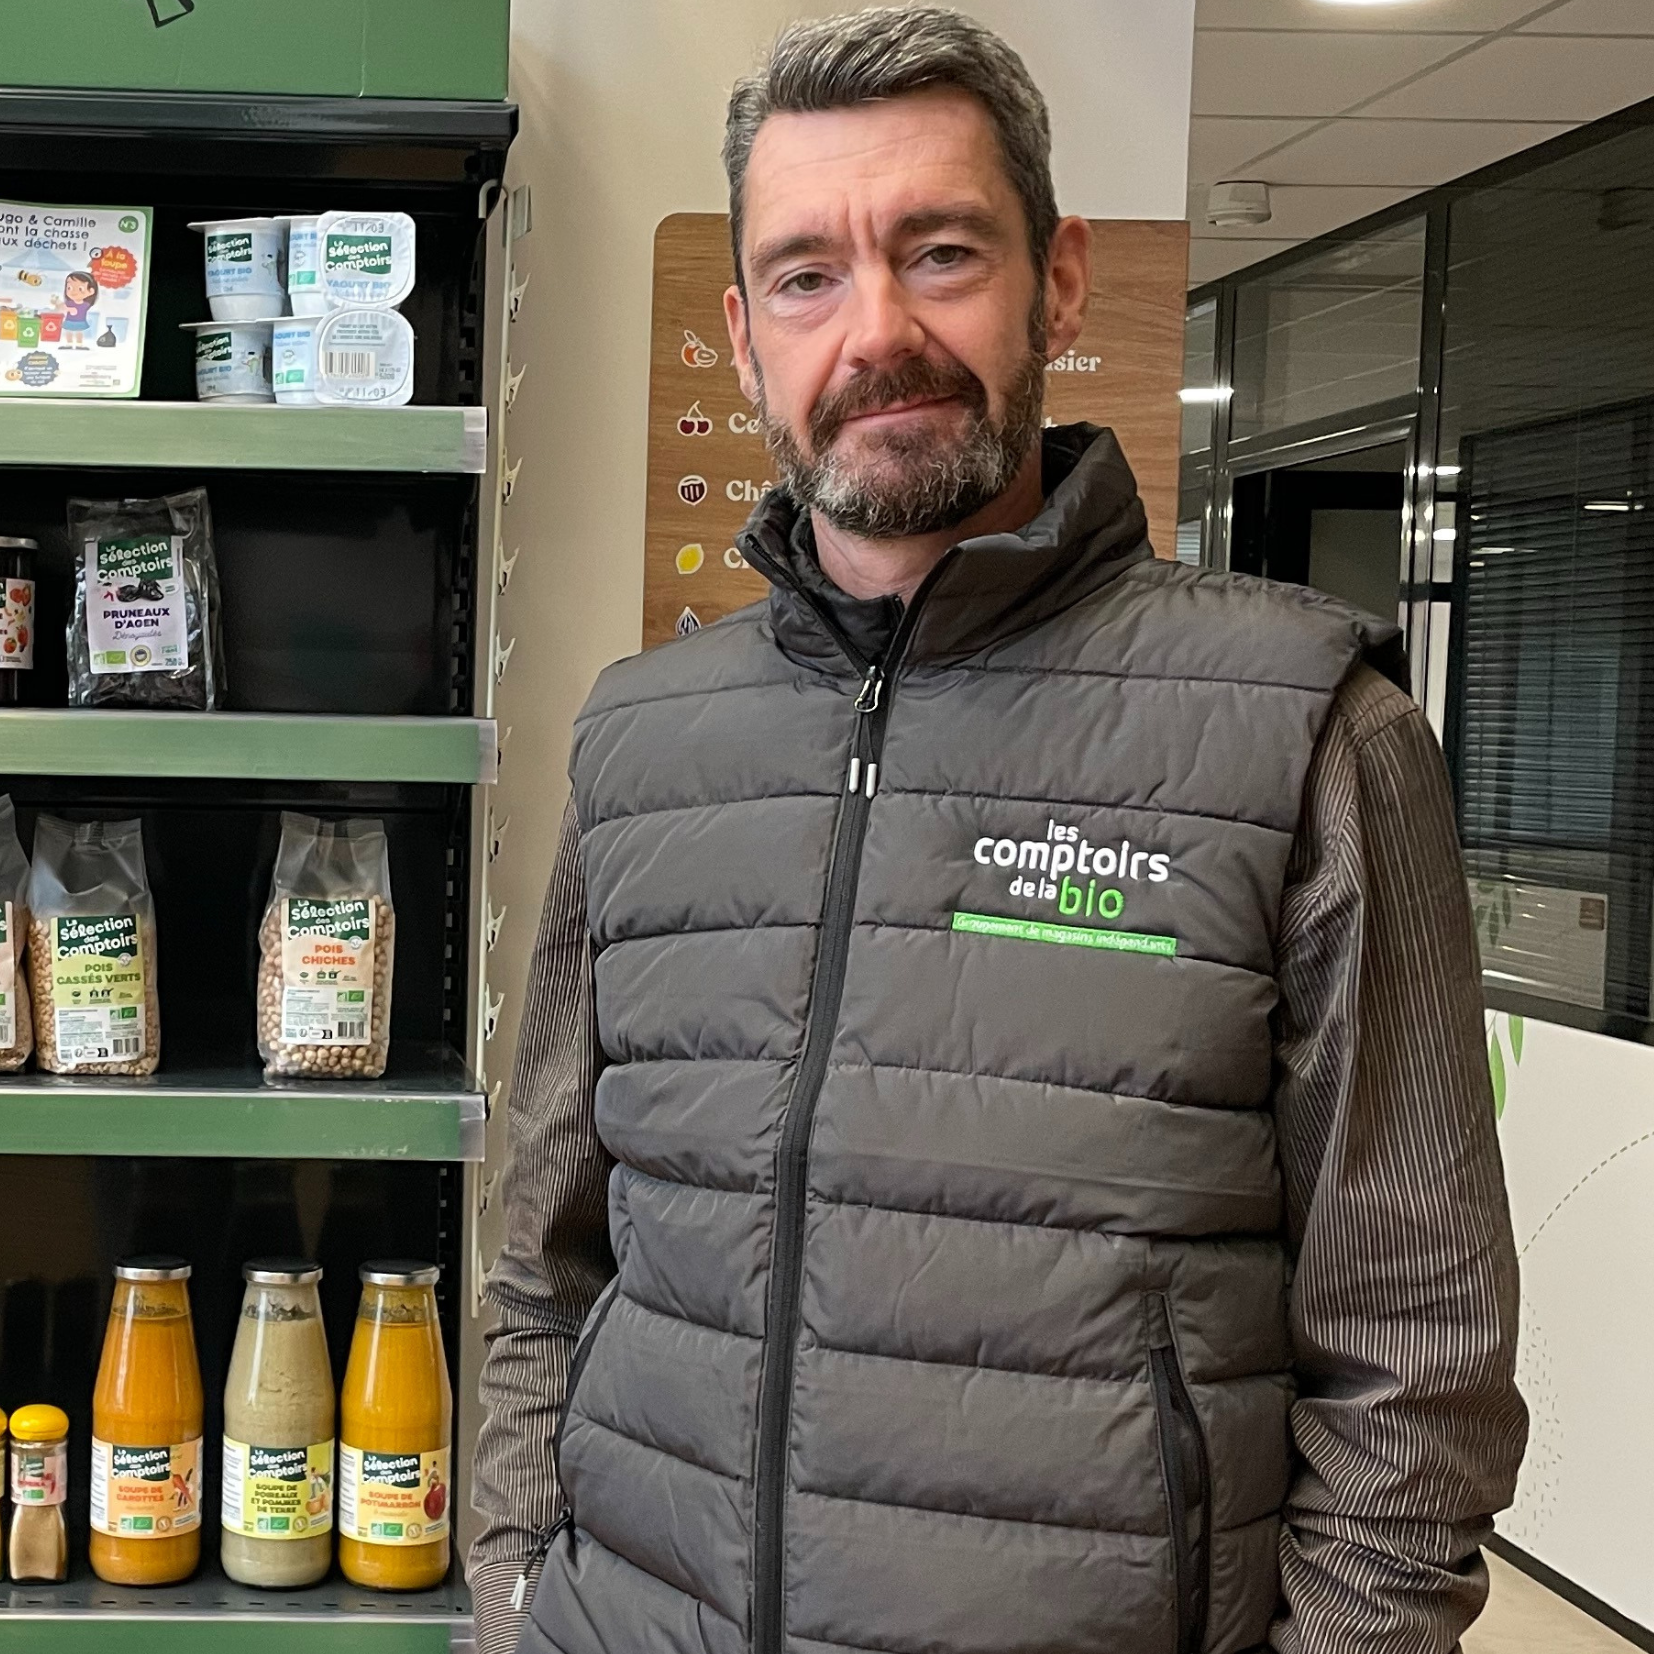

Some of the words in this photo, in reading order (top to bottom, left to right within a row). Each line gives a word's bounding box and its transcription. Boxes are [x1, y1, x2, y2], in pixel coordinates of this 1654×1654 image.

[43, 215, 97, 228] Camille
[25, 226, 38, 236] la
[44, 228, 90, 239] chasse
[24, 238, 78, 251] déchets
[328, 241, 389, 258] Sélection
[325, 254, 393, 273] Comptoirs
[99, 542, 168, 565] Sélection
[97, 556, 173, 581] Comptoirs
[103, 608, 170, 619] PRUNEAUX
[1047, 819, 1080, 842] les
[973, 837, 1171, 882] comptoirs
[1058, 875, 1125, 919] bio
[291, 900, 364, 920] Sélection
[60, 917, 133, 940] Sélection
[288, 916, 370, 939] Comptoirs
[956, 915, 1024, 936] Groupement
[1026, 923, 1040, 937] de
[1041, 929, 1095, 944] magasins
[58, 932, 138, 959] Comptoirs
[315, 944, 343, 954] POIS
[85, 963, 113, 972] POIS
[302, 956, 356, 965] CHICHES
[56, 974, 103, 984] CASSÉS
[105, 973, 141, 983] VERTS
[114, 1450, 168, 1465] Sélection
[251, 1451, 306, 1466] Sélection
[364, 1457, 418, 1472] Sélection
[111, 1462, 171, 1479] Comptoirs
[249, 1462, 308, 1479] Comptoirs
[362, 1468, 421, 1486] Comptoirs
[118, 1486, 149, 1494] SOUPE
[369, 1491, 399, 1500] SOUPE
[117, 1495, 164, 1503] CAROTTES
